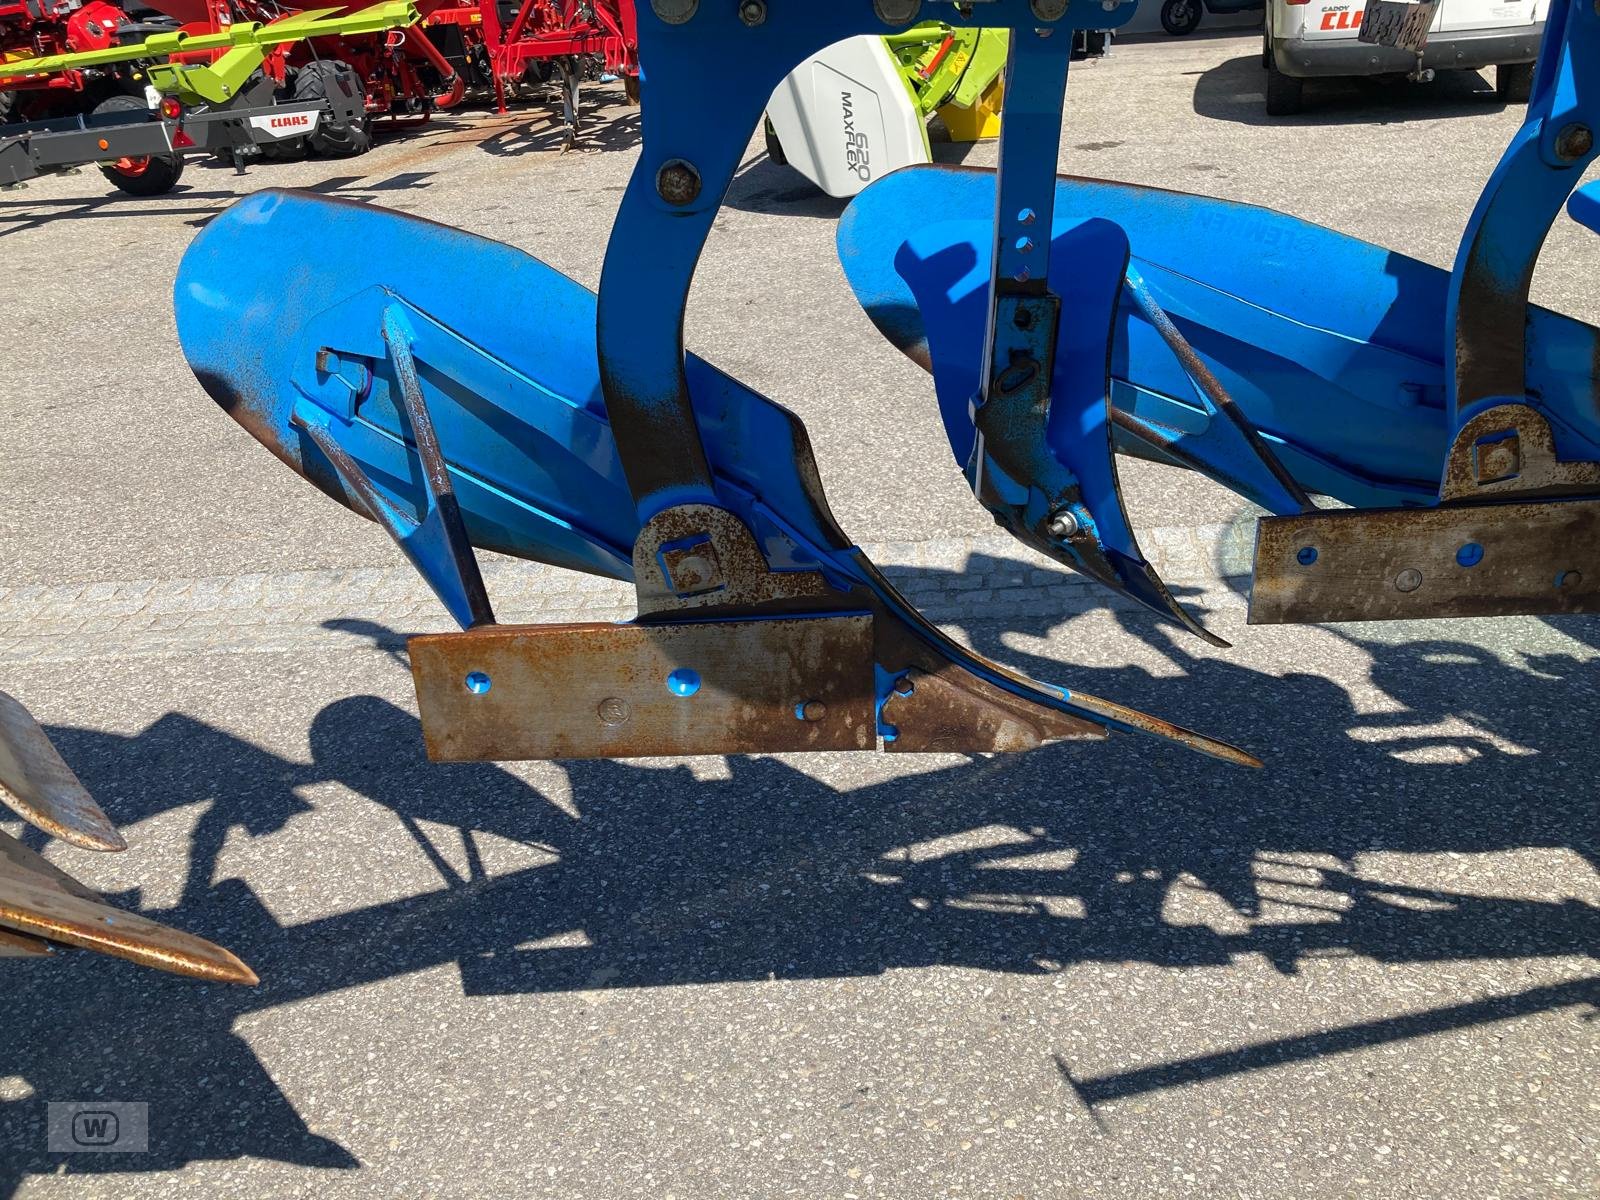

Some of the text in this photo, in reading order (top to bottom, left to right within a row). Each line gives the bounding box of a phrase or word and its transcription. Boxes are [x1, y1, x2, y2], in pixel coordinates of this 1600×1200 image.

[271, 115, 308, 128] CLAAS
[841, 91, 858, 172] MAXFLEX
[855, 132, 871, 182] 620
